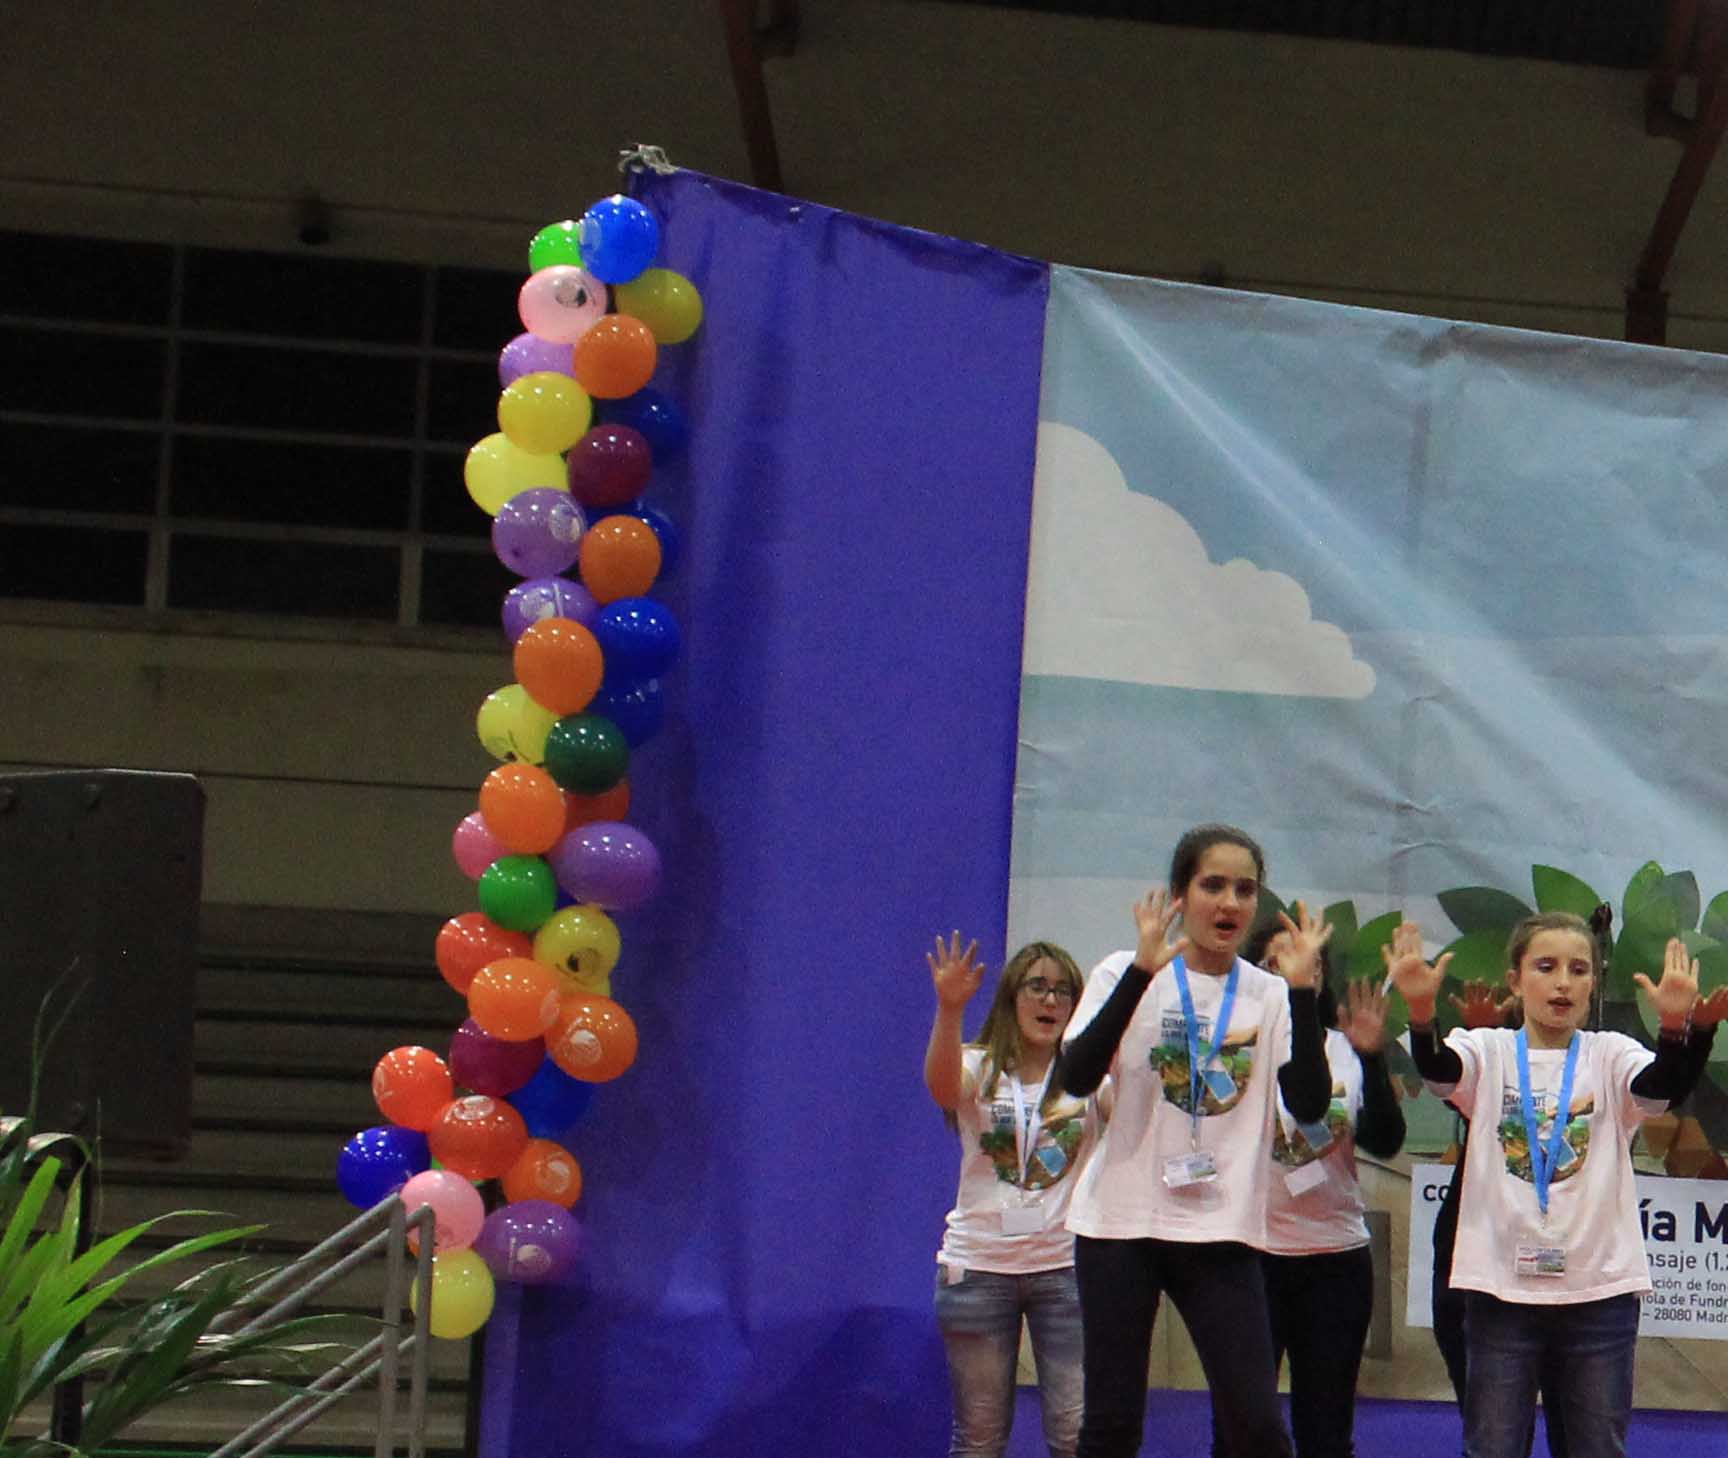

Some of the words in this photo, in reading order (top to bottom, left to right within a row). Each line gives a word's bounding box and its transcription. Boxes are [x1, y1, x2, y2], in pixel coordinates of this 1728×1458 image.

[1686, 1279, 1701, 1291] de
[1670, 1294, 1686, 1305] de
[1654, 1308, 1692, 1321] 28080
